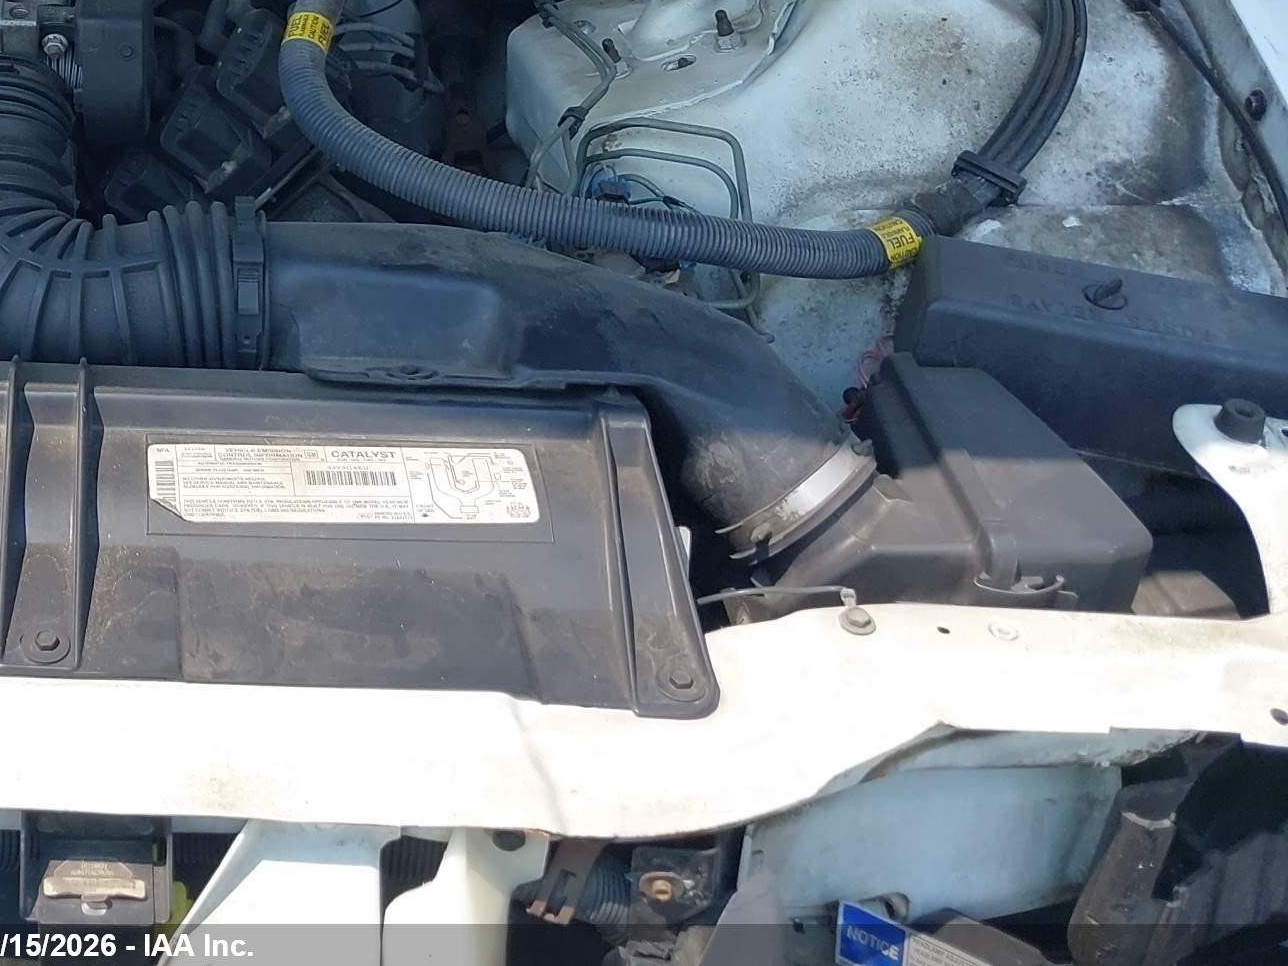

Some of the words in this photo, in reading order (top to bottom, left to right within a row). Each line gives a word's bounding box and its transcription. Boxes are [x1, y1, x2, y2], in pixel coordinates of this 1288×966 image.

[288, 14, 303, 38] FUEL
[887, 232, 916, 251] FUEL
[331, 450, 397, 459] CATALYST
[846, 924, 901, 962] NOTICE
